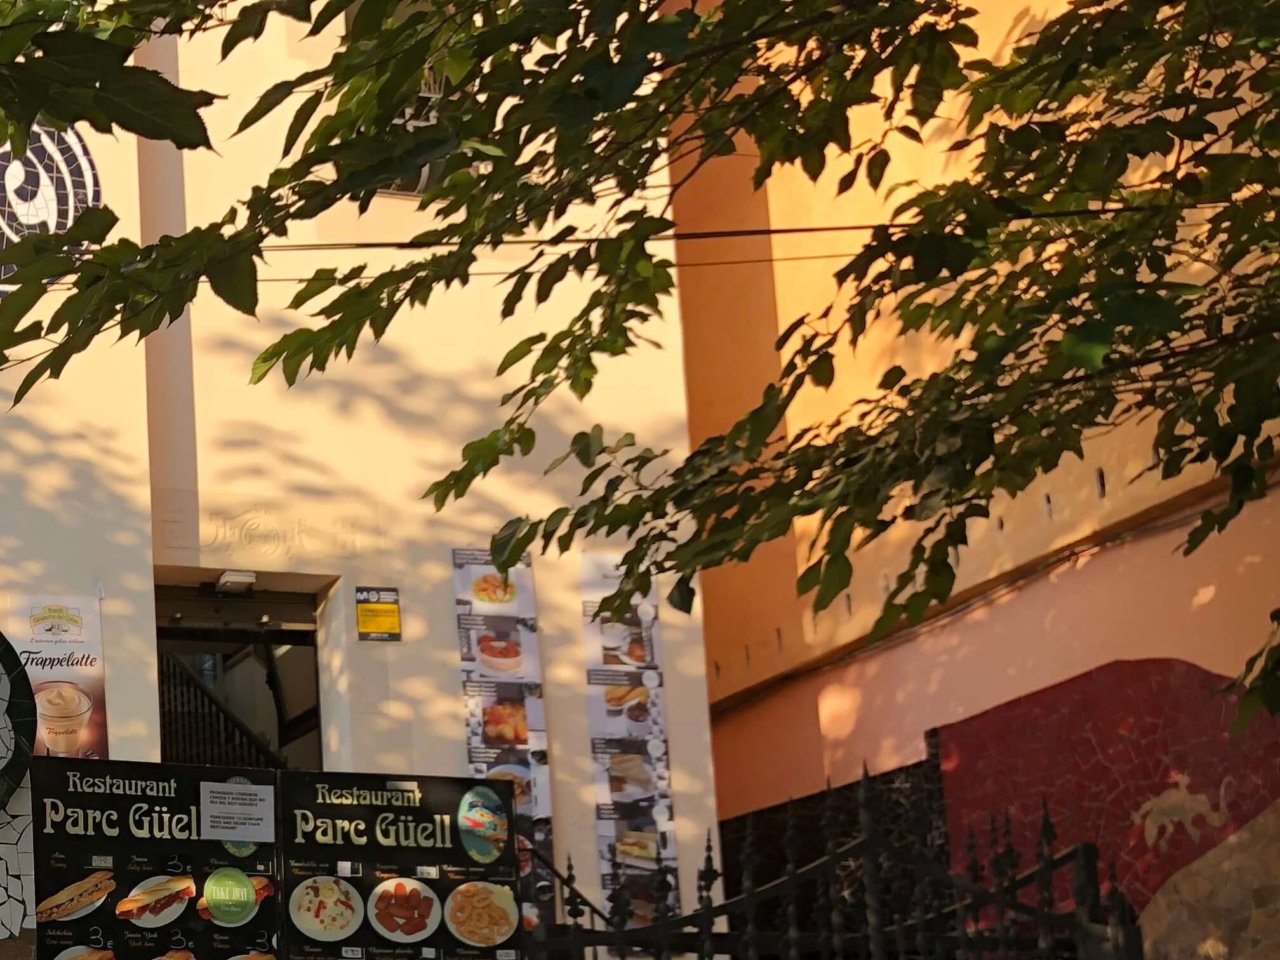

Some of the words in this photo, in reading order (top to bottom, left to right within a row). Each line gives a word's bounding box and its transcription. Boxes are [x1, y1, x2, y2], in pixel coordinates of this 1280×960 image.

[66, 771, 177, 797] Restaurant
[315, 783, 422, 807] Restaurant
[42, 798, 120, 836] Parc
[128, 803, 200, 840] Güel
[293, 809, 368, 845] Parc
[375, 812, 453, 848] Güell
[167, 854, 184, 873] 3
[89, 926, 104, 948] 3
[170, 928, 187, 949] 3
[255, 929, 270, 951] 3
